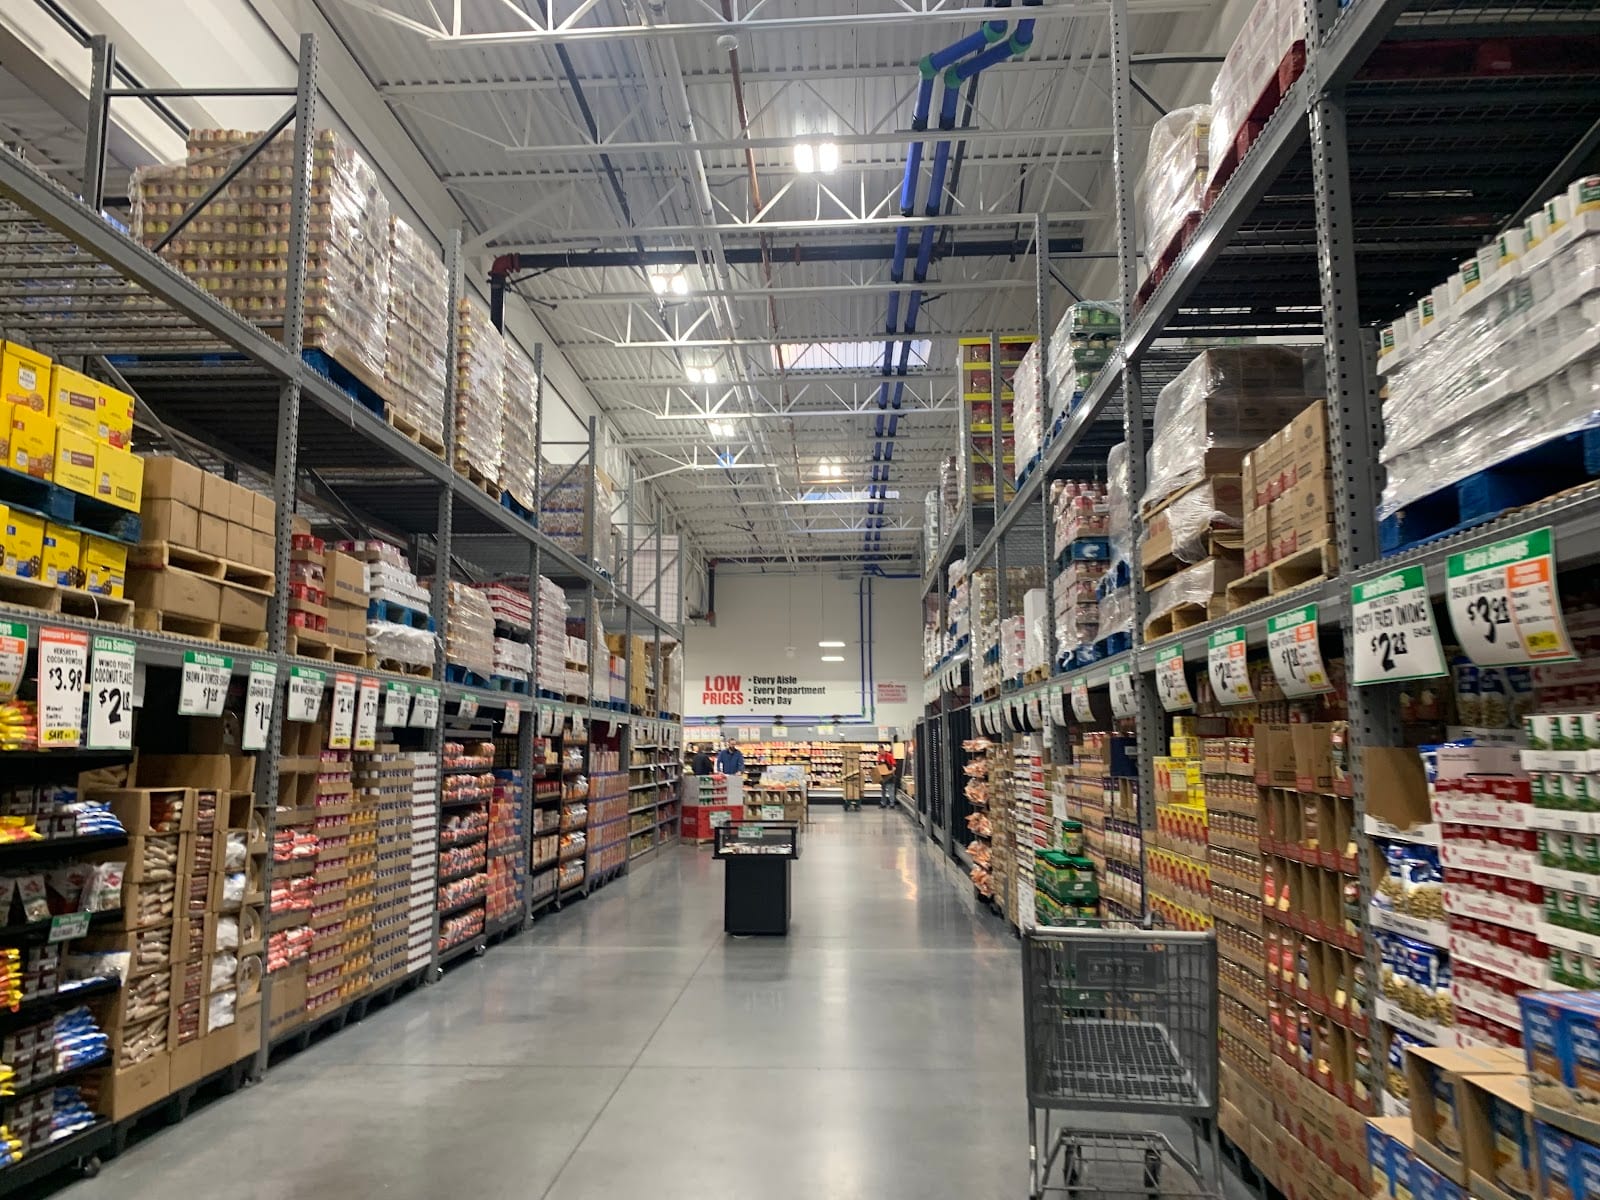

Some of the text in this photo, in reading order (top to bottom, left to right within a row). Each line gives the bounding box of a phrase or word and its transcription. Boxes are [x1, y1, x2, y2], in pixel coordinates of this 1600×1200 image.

[95, 636, 112, 650] Extra
[98, 659, 117, 667] WINCO
[48, 667, 83, 692] $3.98
[94, 668, 118, 684] COCONUT
[753, 675, 797, 686] Every Aisle
[705, 675, 742, 692] LOW
[753, 686, 826, 696] Every Department
[702, 692, 744, 705] PRICES
[753, 696, 793, 706] Every Day
